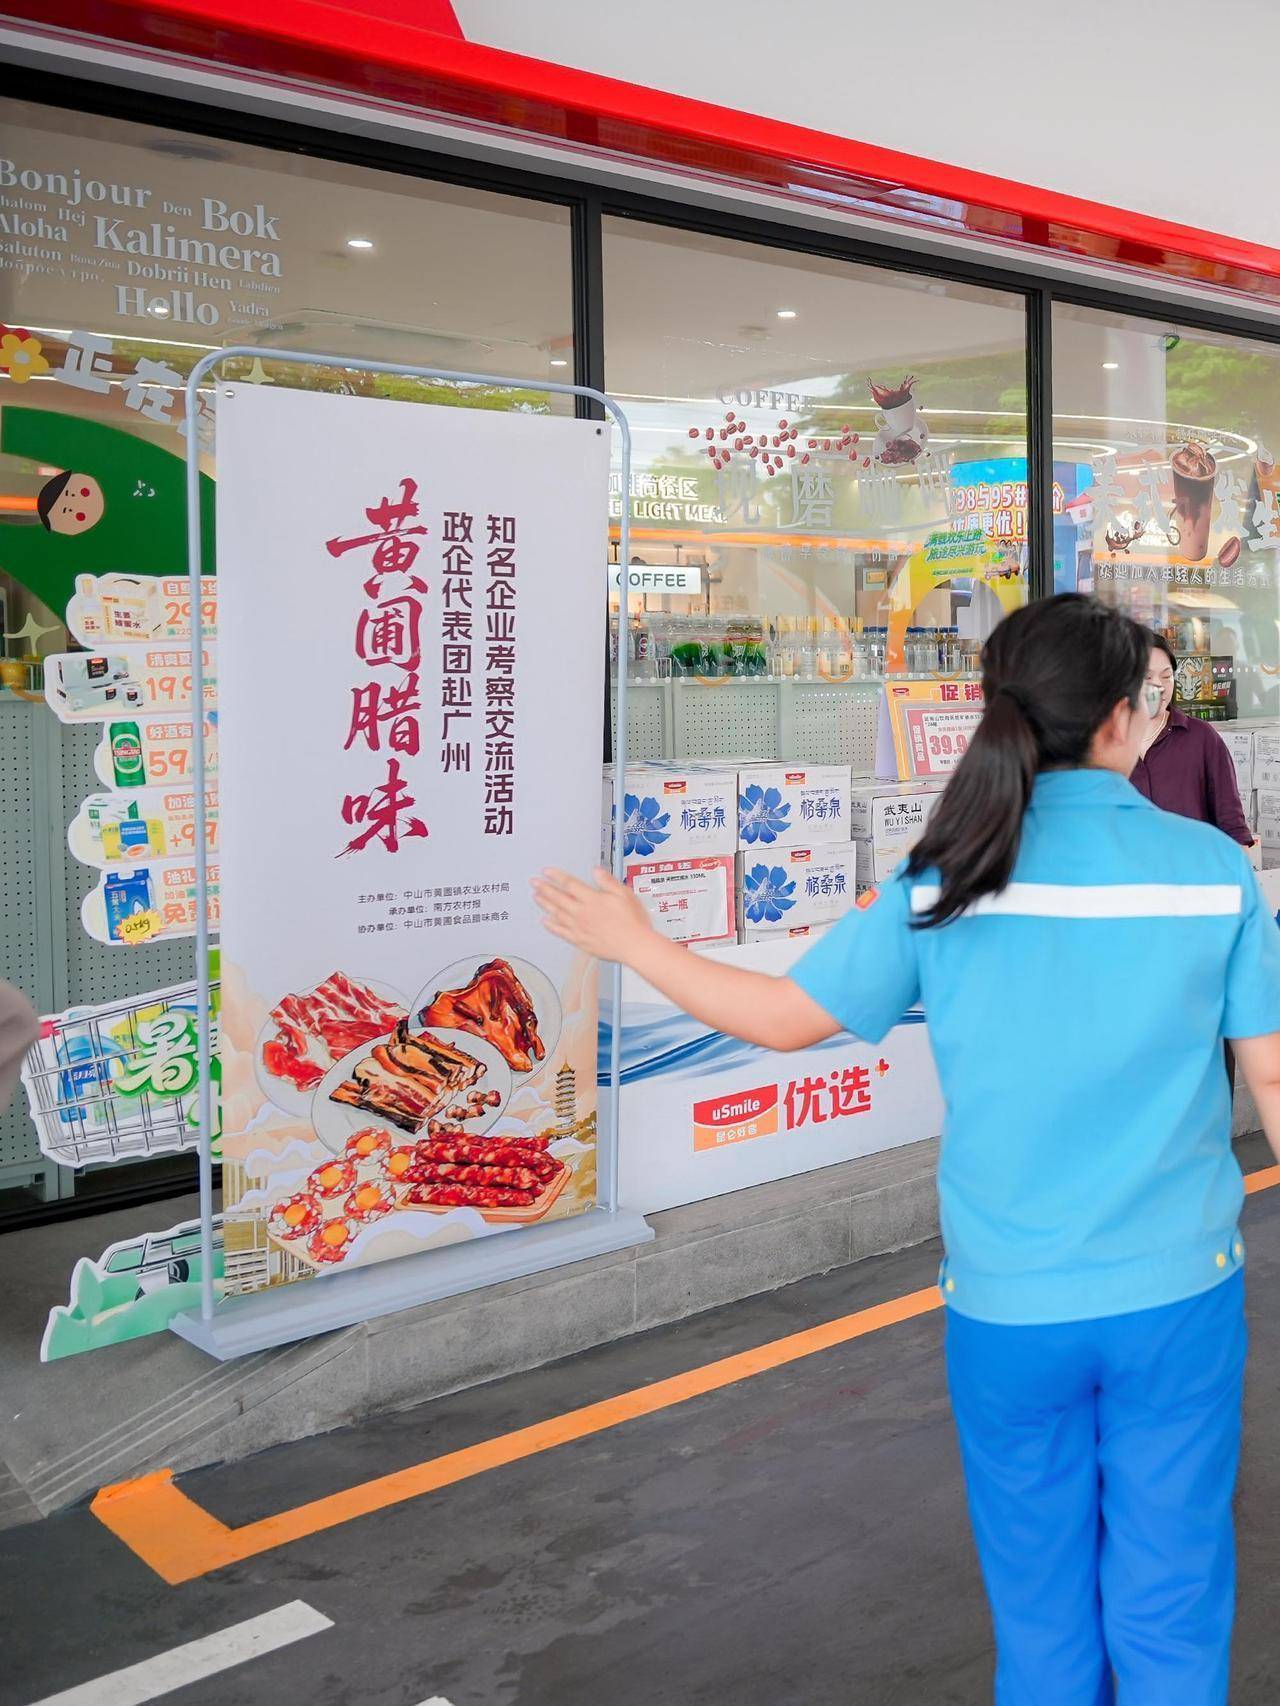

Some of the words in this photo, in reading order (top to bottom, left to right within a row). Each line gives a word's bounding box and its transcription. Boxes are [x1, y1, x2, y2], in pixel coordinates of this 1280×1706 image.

[0, 159, 152, 209] Bonjour
[163, 201, 193, 217] Den
[200, 197, 281, 241] Bok
[0, 194, 47, 212] halom
[58, 207, 86, 227] Hej
[0, 213, 68, 241] Aloha
[93, 215, 283, 278] Kalimera
[127, 260, 189, 284] Dobrii
[114, 285, 220, 326] Hello
[716, 387, 816, 415] COFFEE
[634, 500, 682, 520] LIGHT
[441, 511, 473, 773] 政企代表团赴广州
[326, 477, 430, 859] 黄圃腊味
[484, 514, 517, 835] 知名企业考察交流活动
[940, 684, 984, 702] 促销
[929, 734, 968, 756] 39.9
[149, 749, 188, 777] 59
[884, 803, 922, 816] 武夷山
[712, 1098, 762, 1121] uSmile
[783, 1065, 872, 1131] 优选
